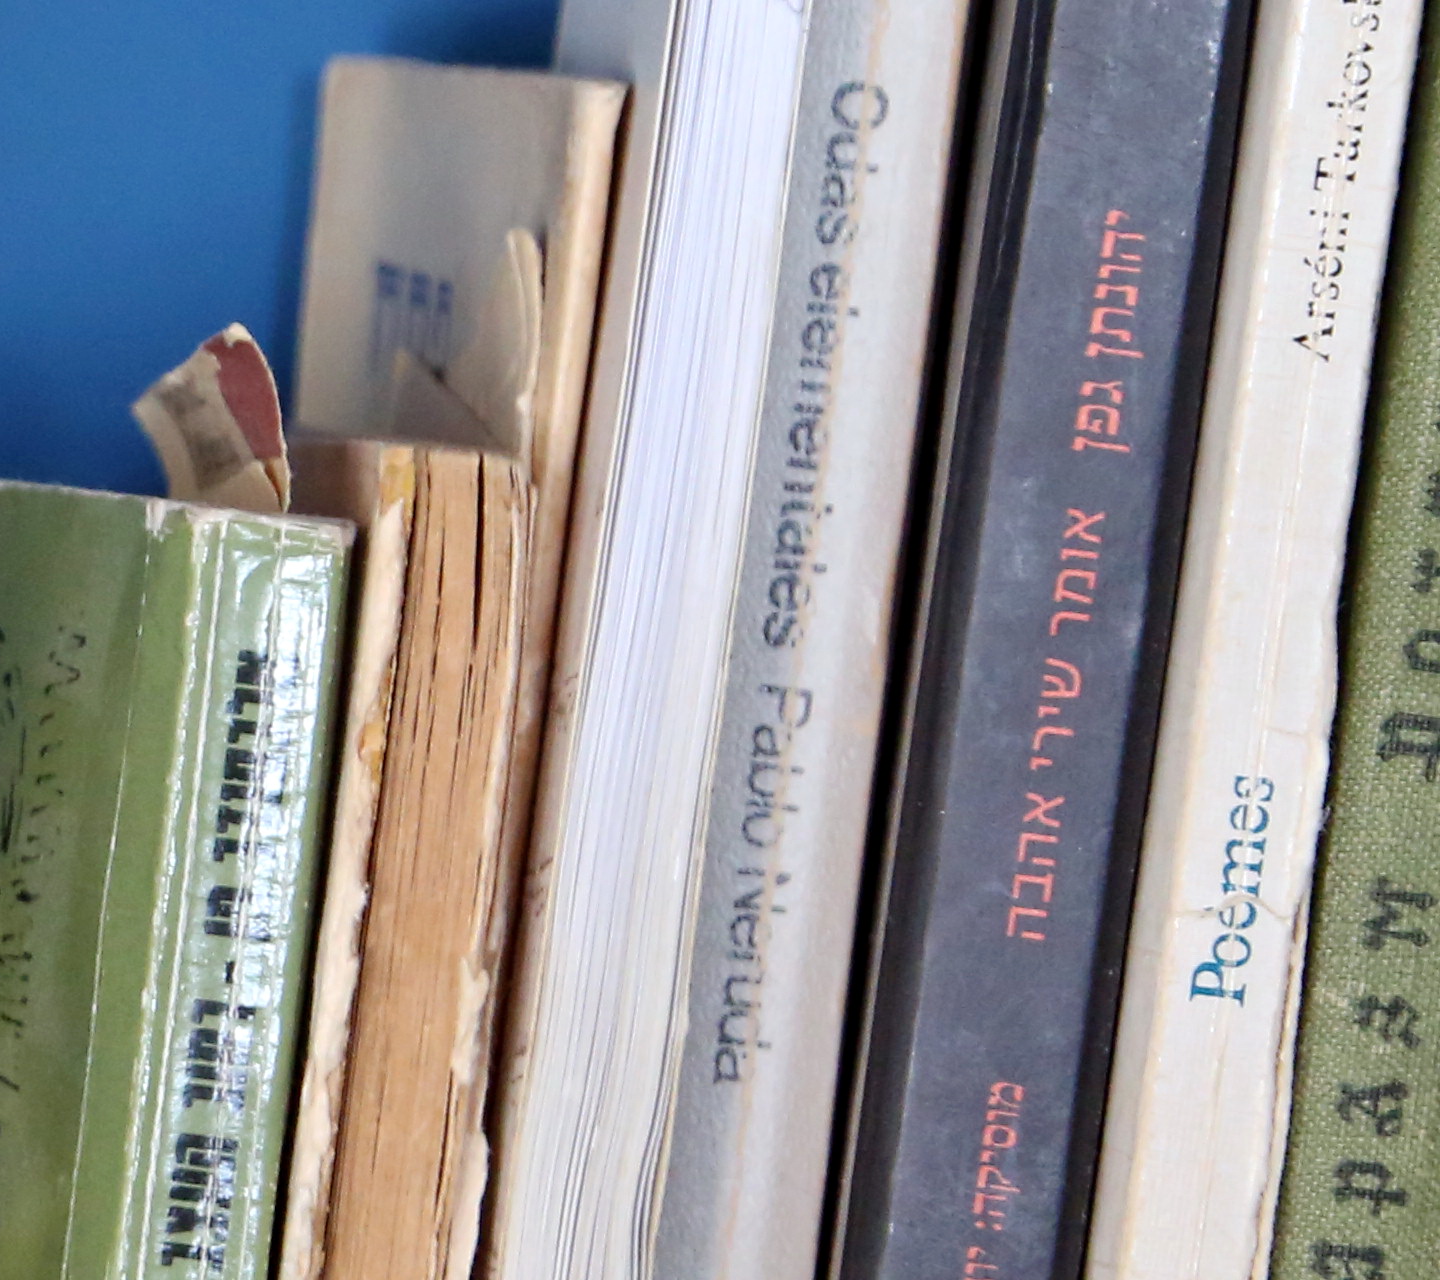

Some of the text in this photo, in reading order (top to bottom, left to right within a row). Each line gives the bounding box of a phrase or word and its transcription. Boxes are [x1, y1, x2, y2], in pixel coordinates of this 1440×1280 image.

[1072, 211, 1143, 452] יהונתן גפן
[742, 683, 813, 848] Pablo
[1008, 508, 1104, 940] אומר שירי אהבה
[713, 867, 792, 1085] Neruda
